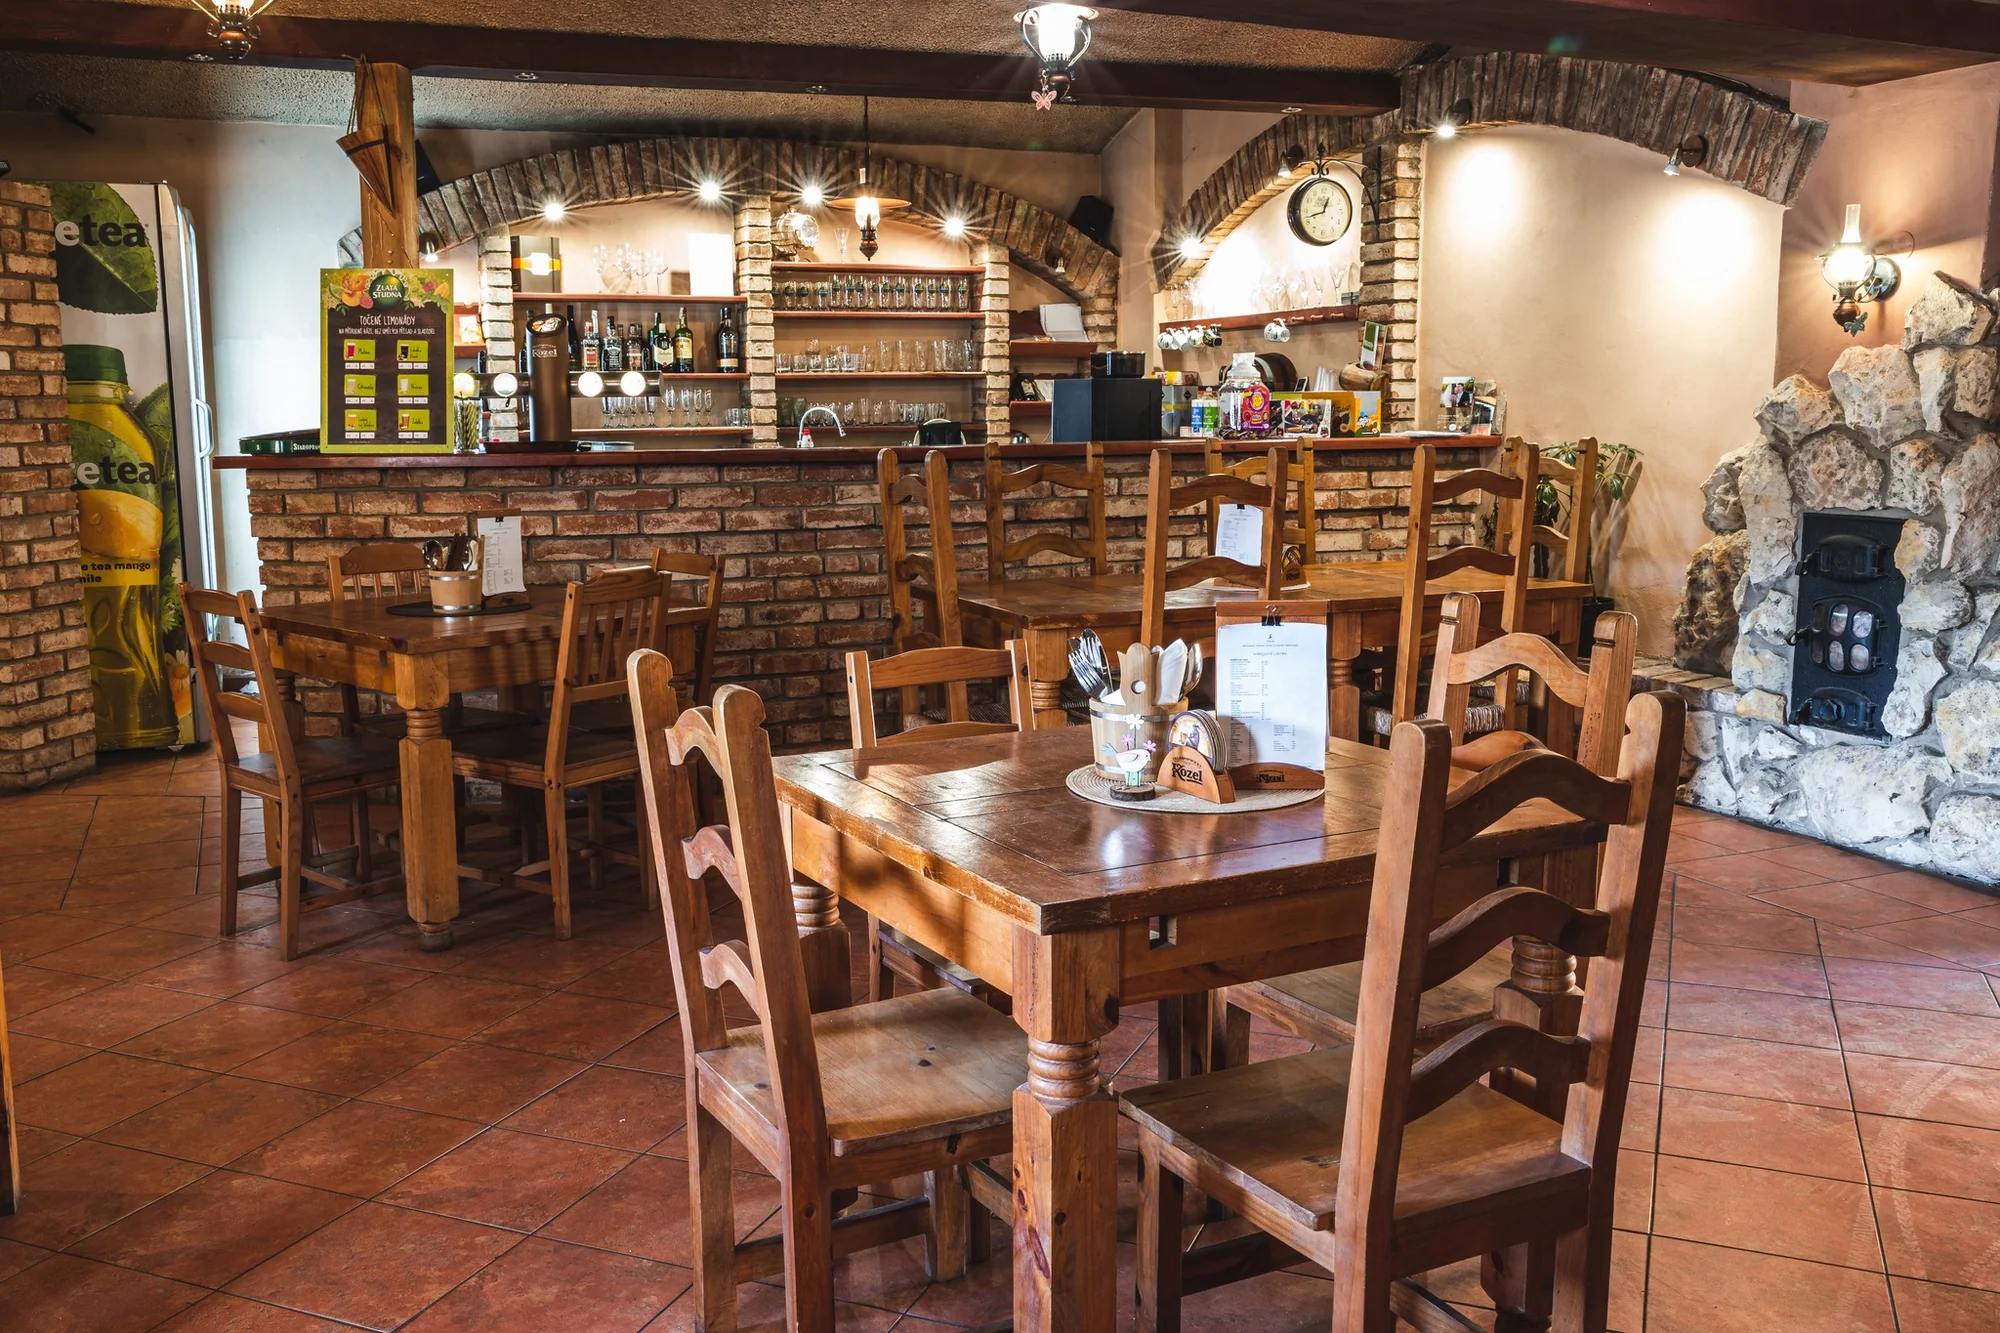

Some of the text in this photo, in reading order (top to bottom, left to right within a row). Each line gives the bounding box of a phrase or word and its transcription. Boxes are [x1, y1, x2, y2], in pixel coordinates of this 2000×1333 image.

[359, 314, 416, 326] TOČENÉ LIMONÁDY
[532, 348, 558, 358] Kozel
[90, 562, 112, 571] tea
[114, 561, 151, 572] mango
[1171, 762, 1203, 784] Kozel
